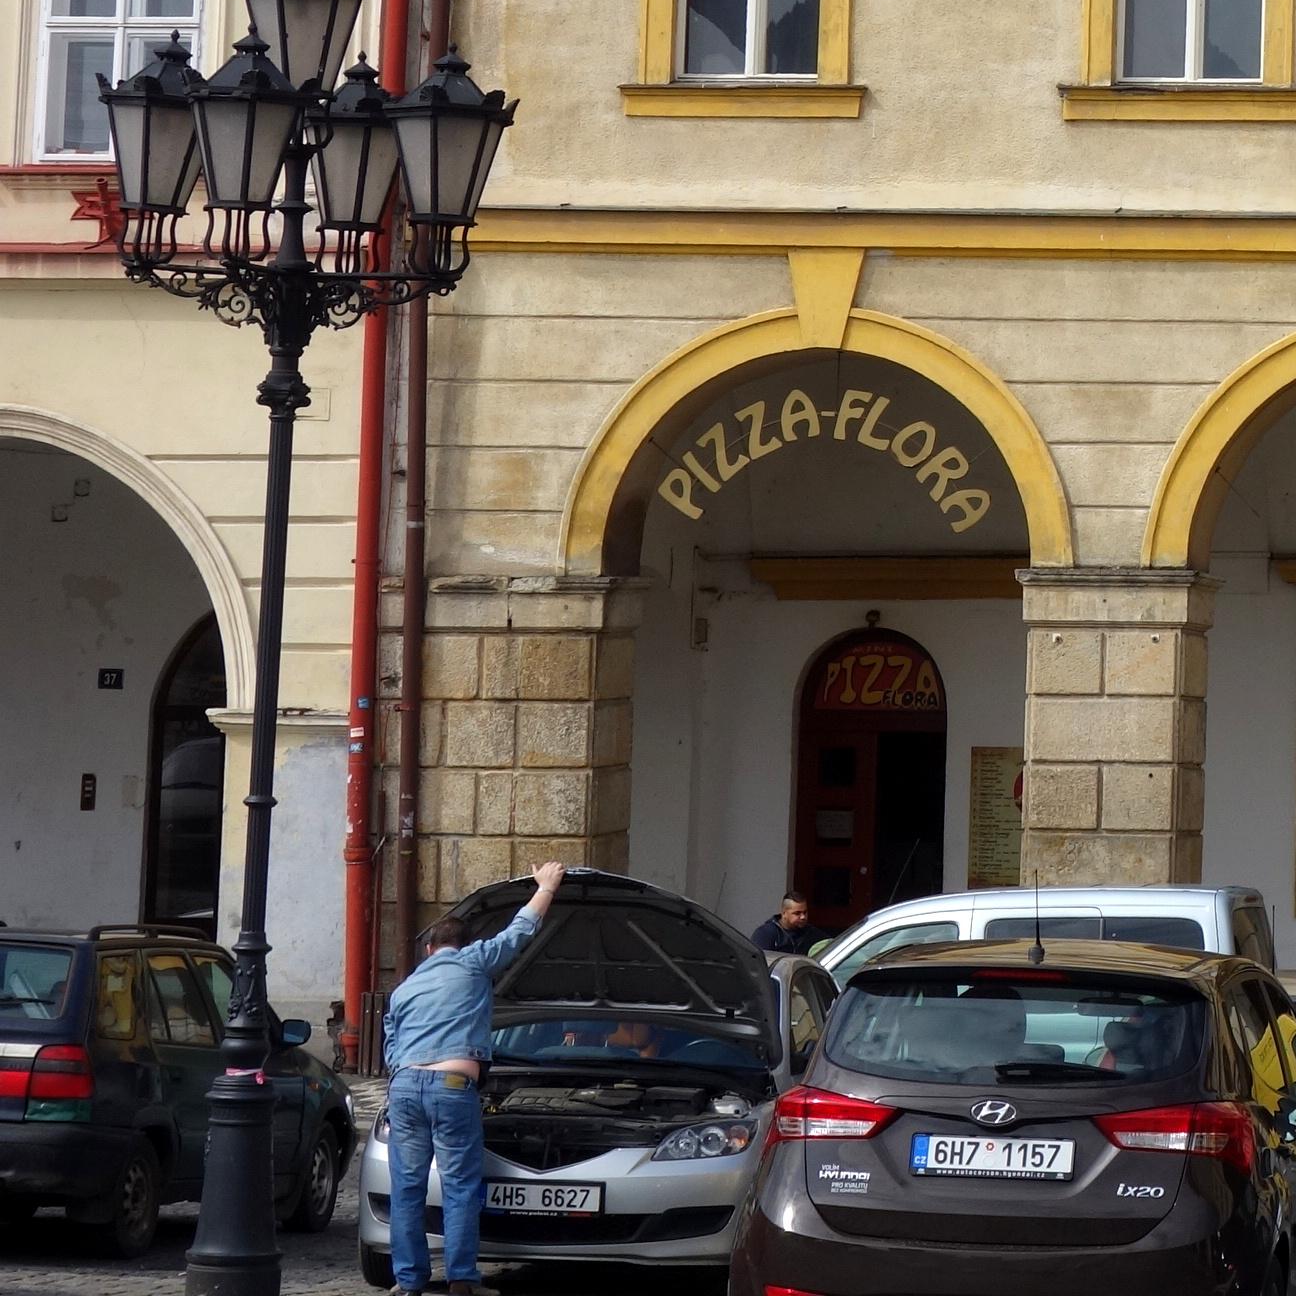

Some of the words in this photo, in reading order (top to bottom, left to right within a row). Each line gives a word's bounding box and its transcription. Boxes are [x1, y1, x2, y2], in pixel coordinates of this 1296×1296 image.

[658, 389, 991, 533] PIZZA-FLORA
[103, 673, 117, 685] 37
[823, 654, 940, 704] PIZZA
[882, 689, 939, 708] FLORA
[914, 1155, 927, 1165] CZ
[934, 1140, 980, 1166] 6H7
[1001, 1142, 1062, 1169] 1157
[491, 1186, 526, 1207] 4H5
[541, 1188, 590, 1208] 6627
[1116, 1183, 1165, 1199] ix20
